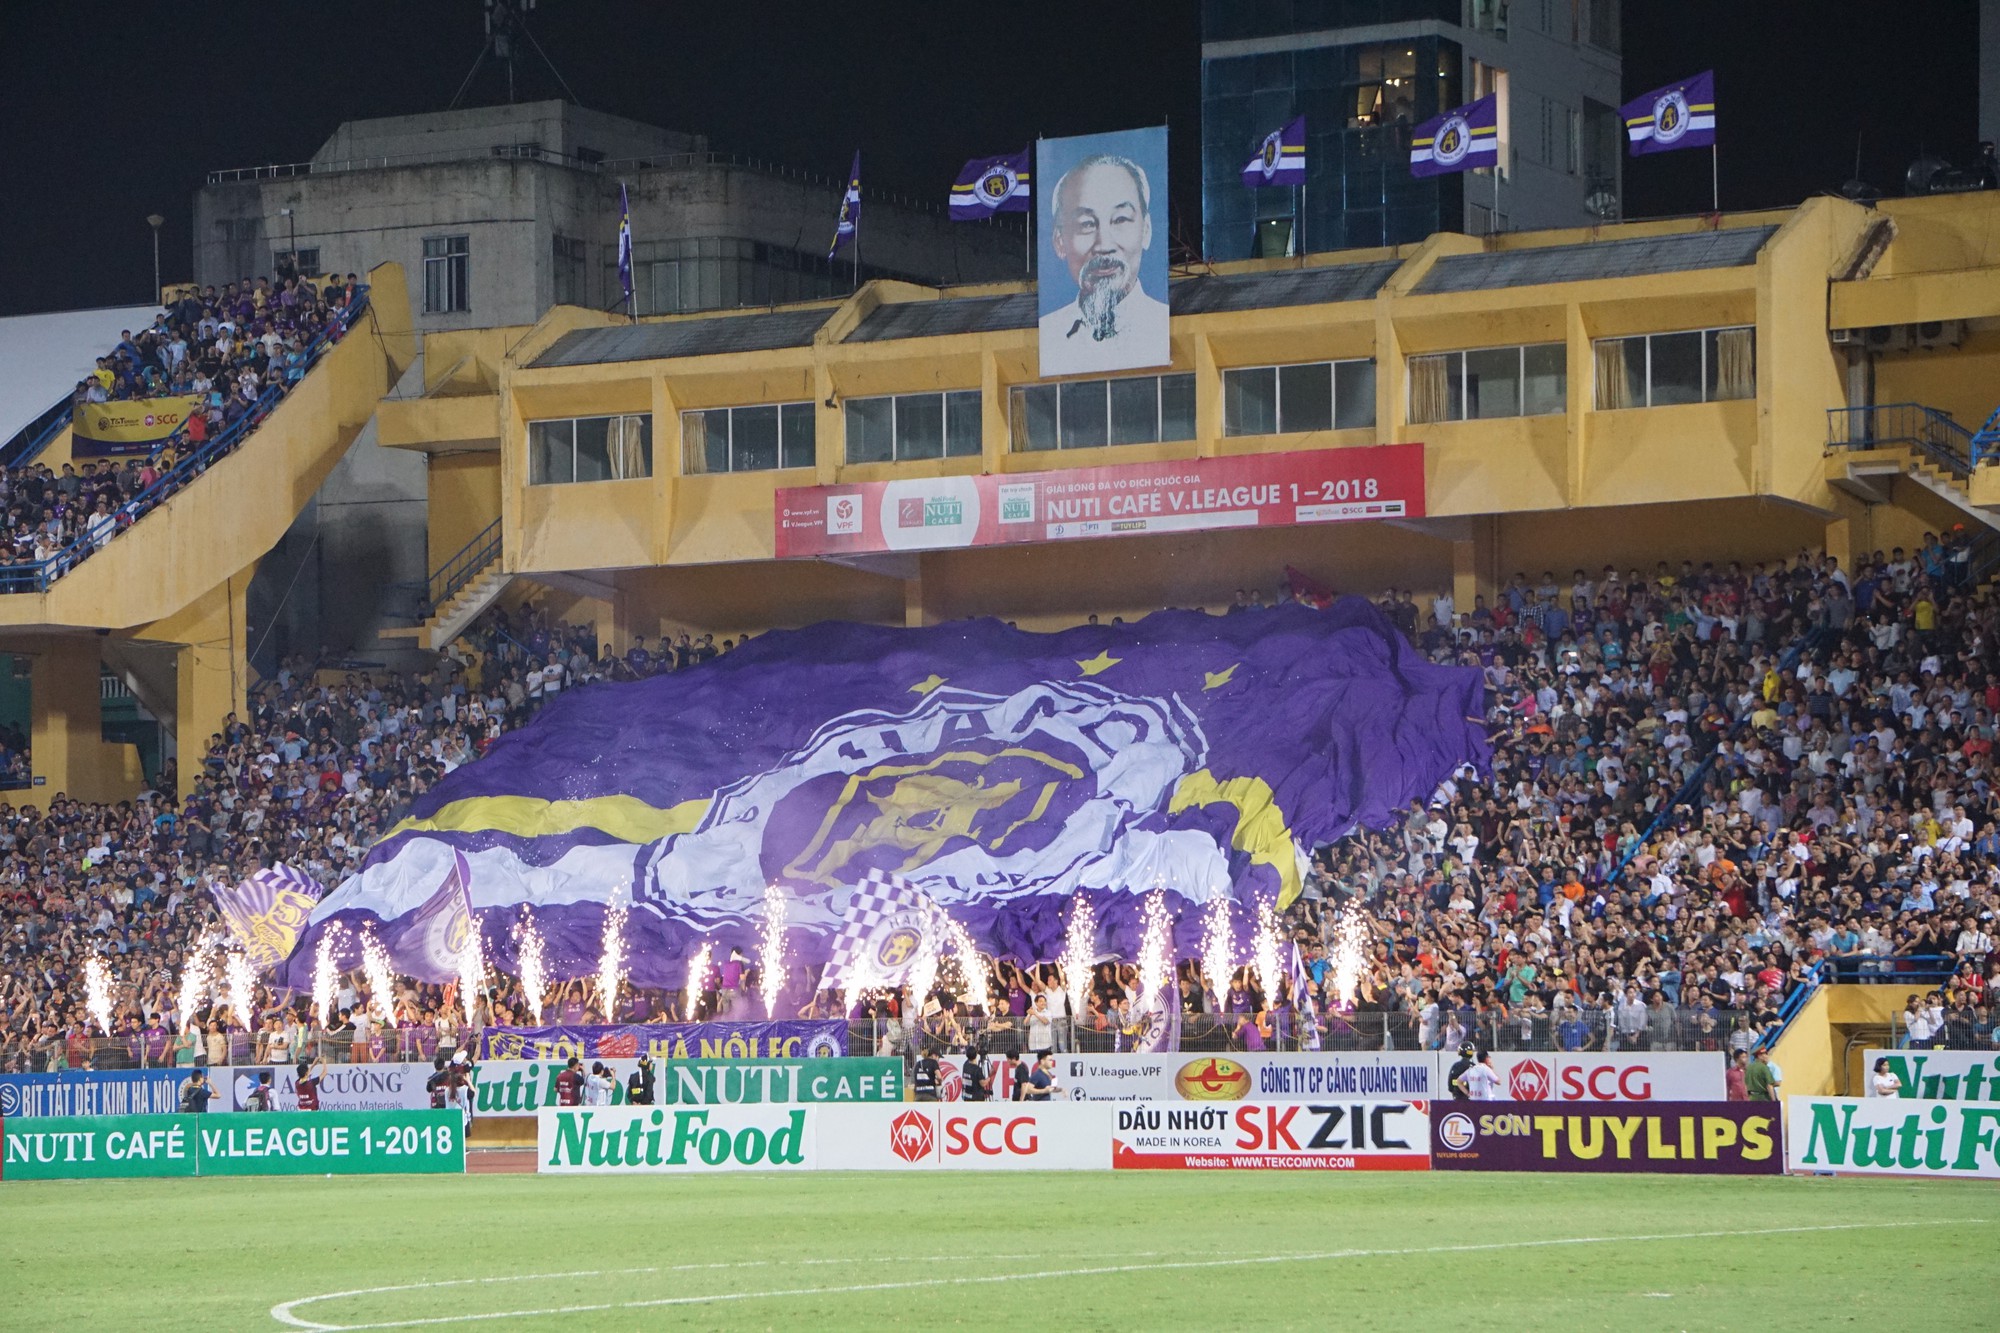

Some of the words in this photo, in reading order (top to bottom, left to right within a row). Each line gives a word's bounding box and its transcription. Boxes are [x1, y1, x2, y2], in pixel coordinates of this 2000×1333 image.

[156, 413, 178, 425] SCG
[926, 502, 961, 516] NUTI
[1047, 497, 1100, 521] NUTI
[1108, 489, 1161, 516] CAFÉ
[1168, 484, 1280, 511] V.LEAGUE
[837, 521, 853, 530] VPF
[649, 1032, 689, 1059] HÀ
[674, 1064, 803, 1104] NUTI
[812, 1069, 897, 1099] CAFÉ
[1090, 1065, 1162, 1078] V.league.VPF
[1260, 1061, 1290, 1093] CÔNG
[1293, 1066, 1305, 1093] TY
[1309, 1066, 1323, 1093] CP
[1327, 1057, 1356, 1093] CẢNG
[1360, 1057, 1397, 1095] QUẢNG
[1400, 1066, 1428, 1093] NINH
[1562, 1065, 1652, 1101] SCG
[22, 1079, 44, 1117] BÍT
[47, 1073, 71, 1117] TẤT
[103, 1082, 127, 1115] KIM
[132, 1075, 149, 1114] HÀ
[358, 1100, 403, 1111] Materials
[1118, 1102, 1161, 1130] DẦU
[1168, 1105, 1229, 1130] NHỚT
[1479, 1113, 1531, 1136] SƠN
[6, 1132, 96, 1163] NUTI
[105, 1124, 185, 1160] CAFÉ
[202, 1127, 350, 1157] V.LEAGUE
[359, 1125, 453, 1155] 1-2018
[549, 1109, 806, 1167] NutiFood
[945, 1116, 1038, 1155] SCG
[1136, 1137, 1167, 1147] MADE
[1170, 1137, 1180, 1147] IN
[1183, 1137, 1222, 1147] KOREA
[1534, 1115, 1774, 1161] TUYLIPS
[1802, 1103, 2000, 1170] NutiF
[1185, 1156, 1229, 1167] Website:
[1232, 1156, 1355, 1168] WWW.TEKCOMVN.COM
